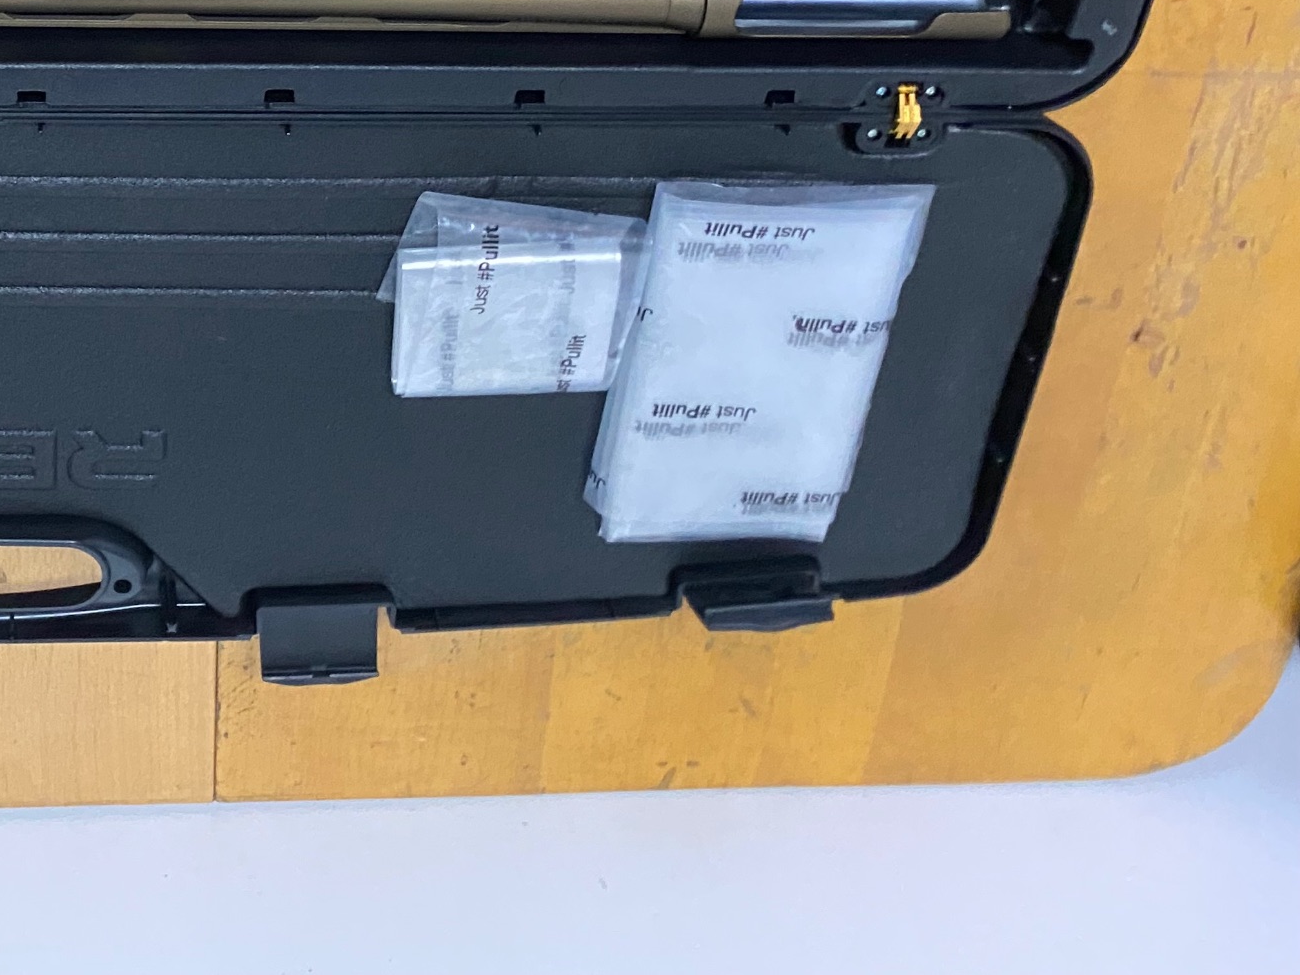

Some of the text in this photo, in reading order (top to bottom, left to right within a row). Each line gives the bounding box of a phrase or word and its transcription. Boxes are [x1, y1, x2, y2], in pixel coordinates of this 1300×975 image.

[704, 222, 815, 241] Just #Pullit
[470, 224, 500, 315] Just #Pullit
[862, 320, 890, 334] ust
[559, 334, 587, 376] #Pullit
[653, 403, 757, 421] Just #Pullit
